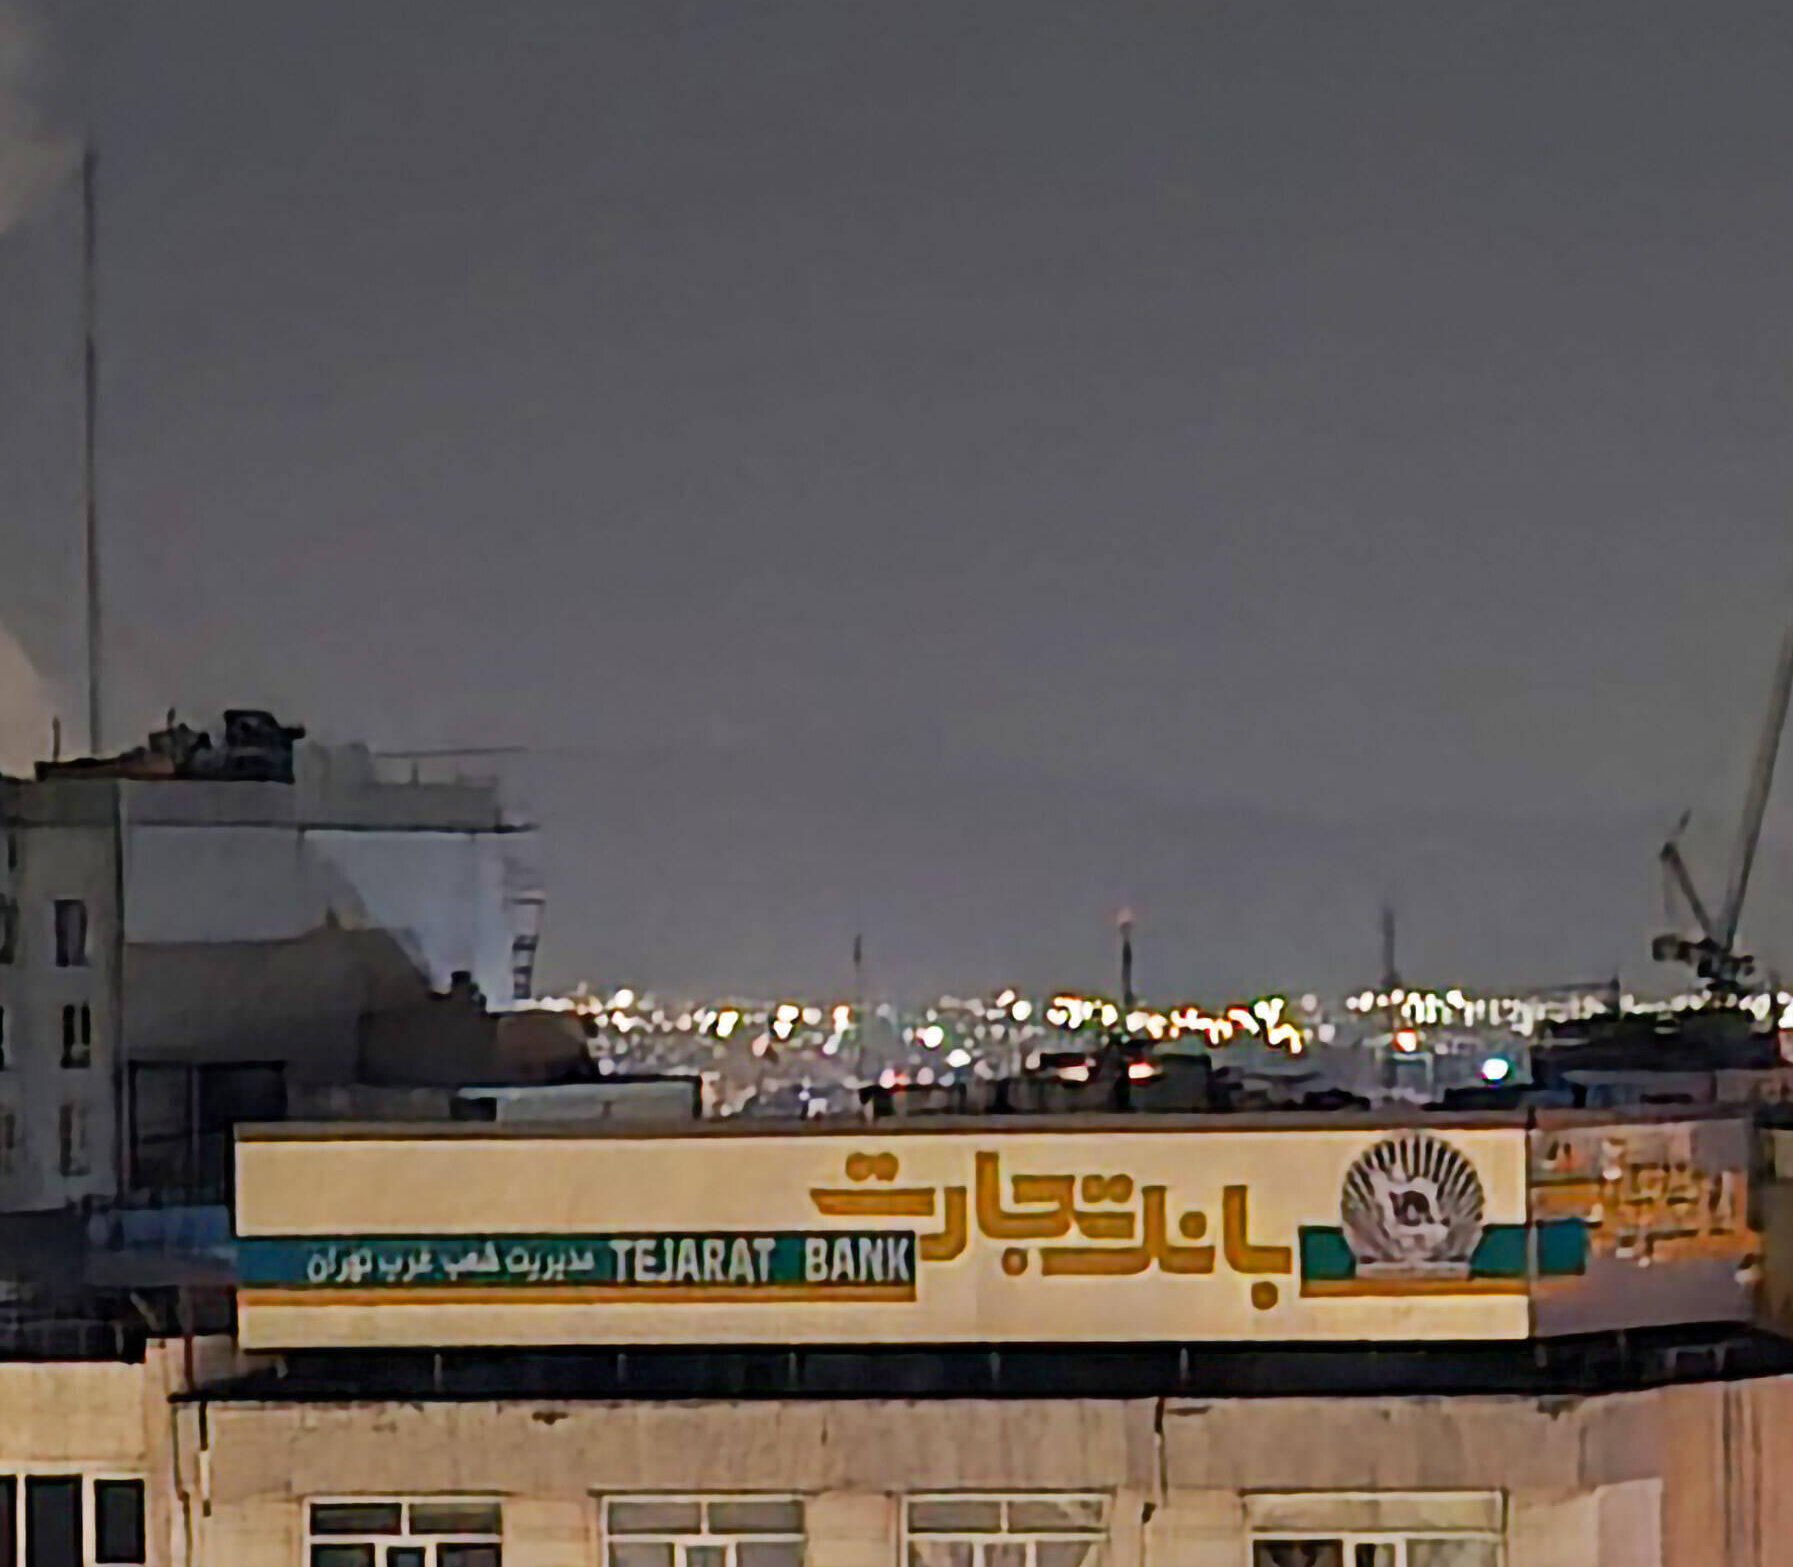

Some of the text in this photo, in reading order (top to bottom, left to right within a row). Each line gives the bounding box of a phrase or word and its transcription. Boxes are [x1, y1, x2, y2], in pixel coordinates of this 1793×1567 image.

[810, 1151, 1293, 1311] بانک تجارت
[306, 1239, 596, 1284] مدیریت شعب غرب تهران
[609, 1236, 909, 1284] TEJARAT BANK
